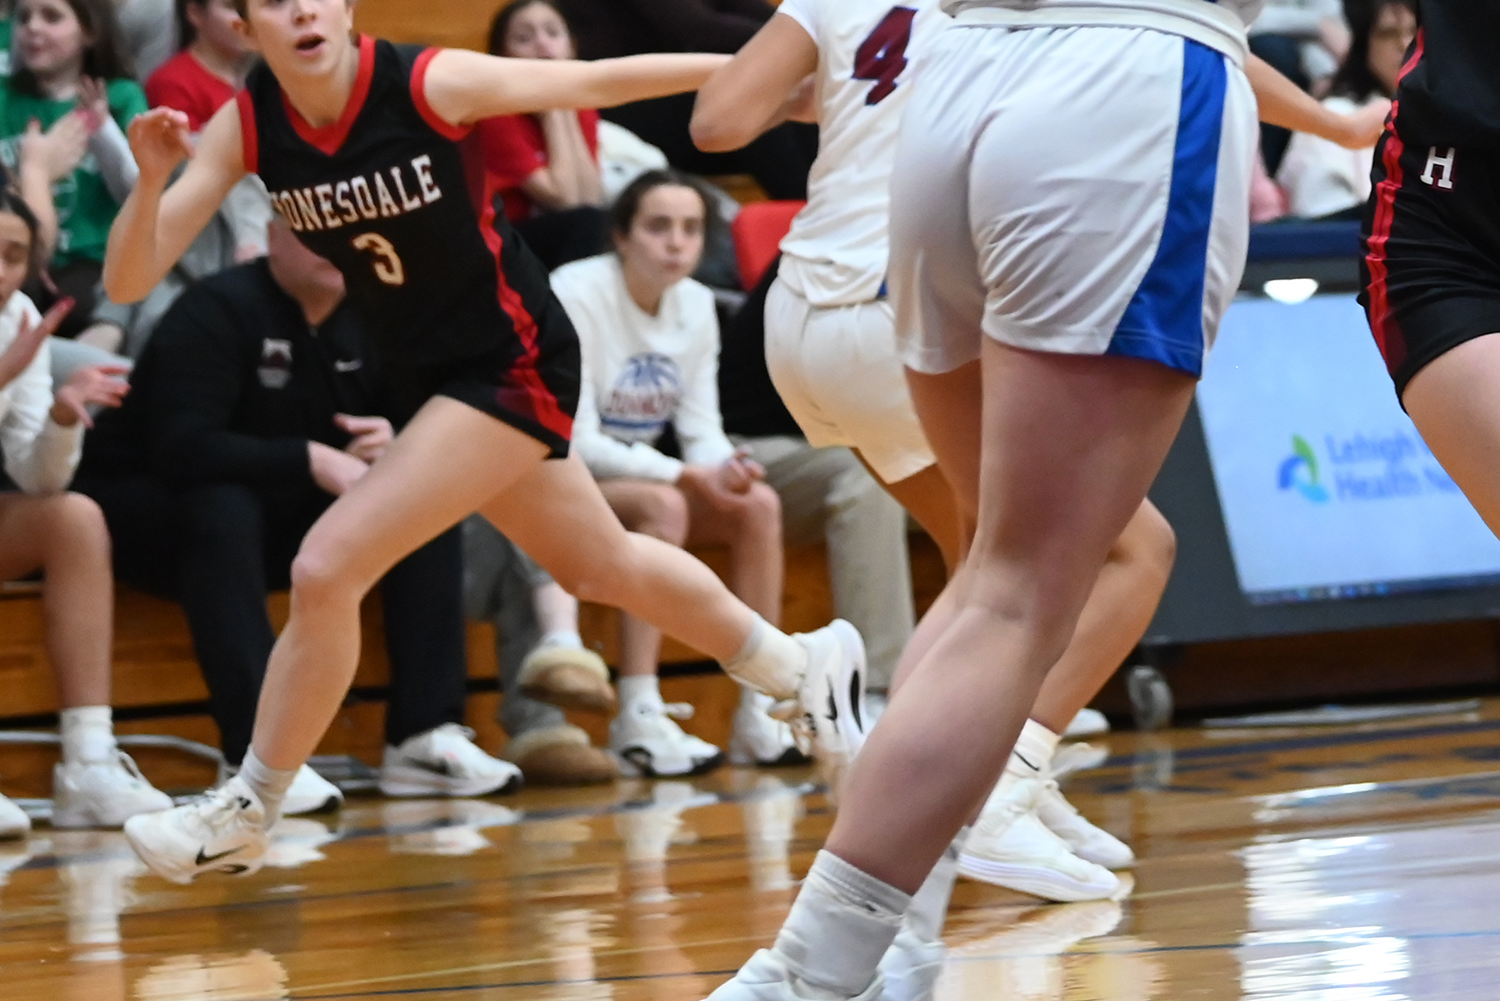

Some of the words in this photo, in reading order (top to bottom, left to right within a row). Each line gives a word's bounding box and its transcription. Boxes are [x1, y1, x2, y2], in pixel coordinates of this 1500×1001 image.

[851, 5, 919, 106] 4
[1420, 146, 1455, 189] H
[353, 232, 404, 286] 3
